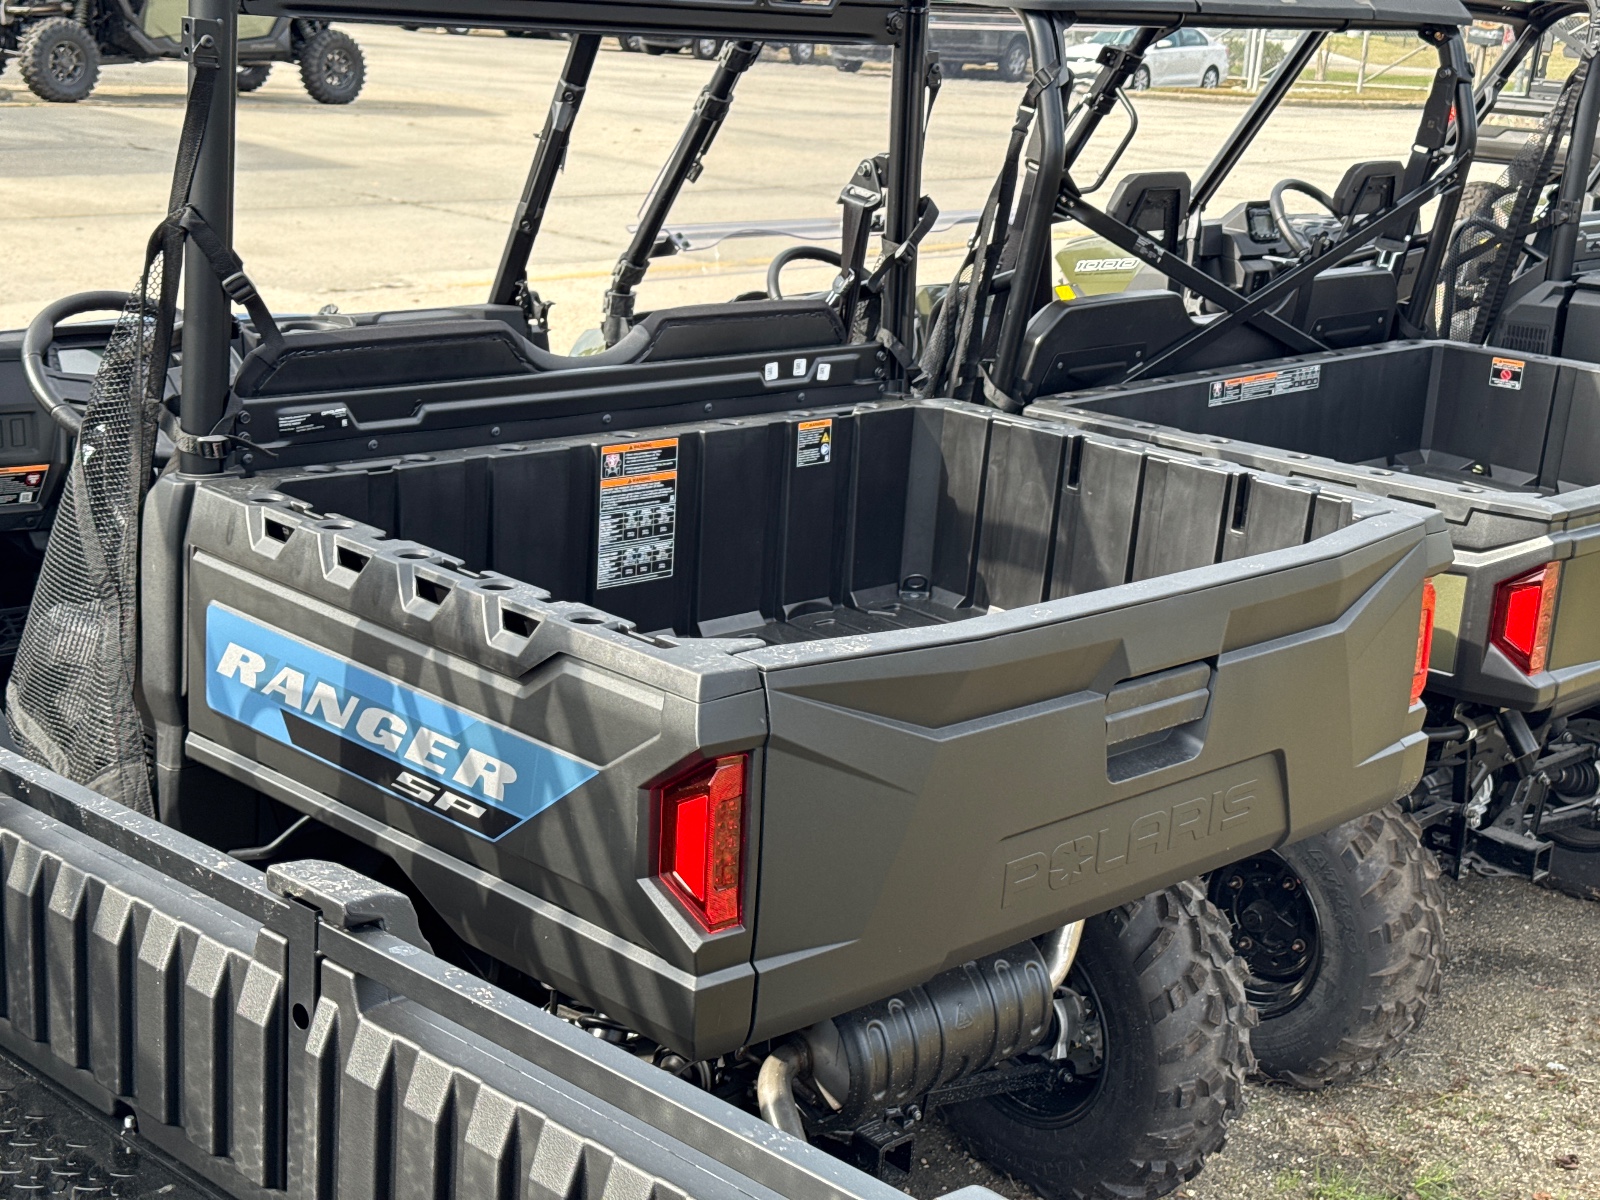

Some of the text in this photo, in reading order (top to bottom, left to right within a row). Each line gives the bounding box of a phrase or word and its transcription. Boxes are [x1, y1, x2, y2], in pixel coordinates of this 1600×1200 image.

[1074, 257, 1140, 272] 1000
[216, 642, 518, 802] RANGER
[391, 771, 486, 819] SP
[1000, 779, 1258, 910] POLARIS
